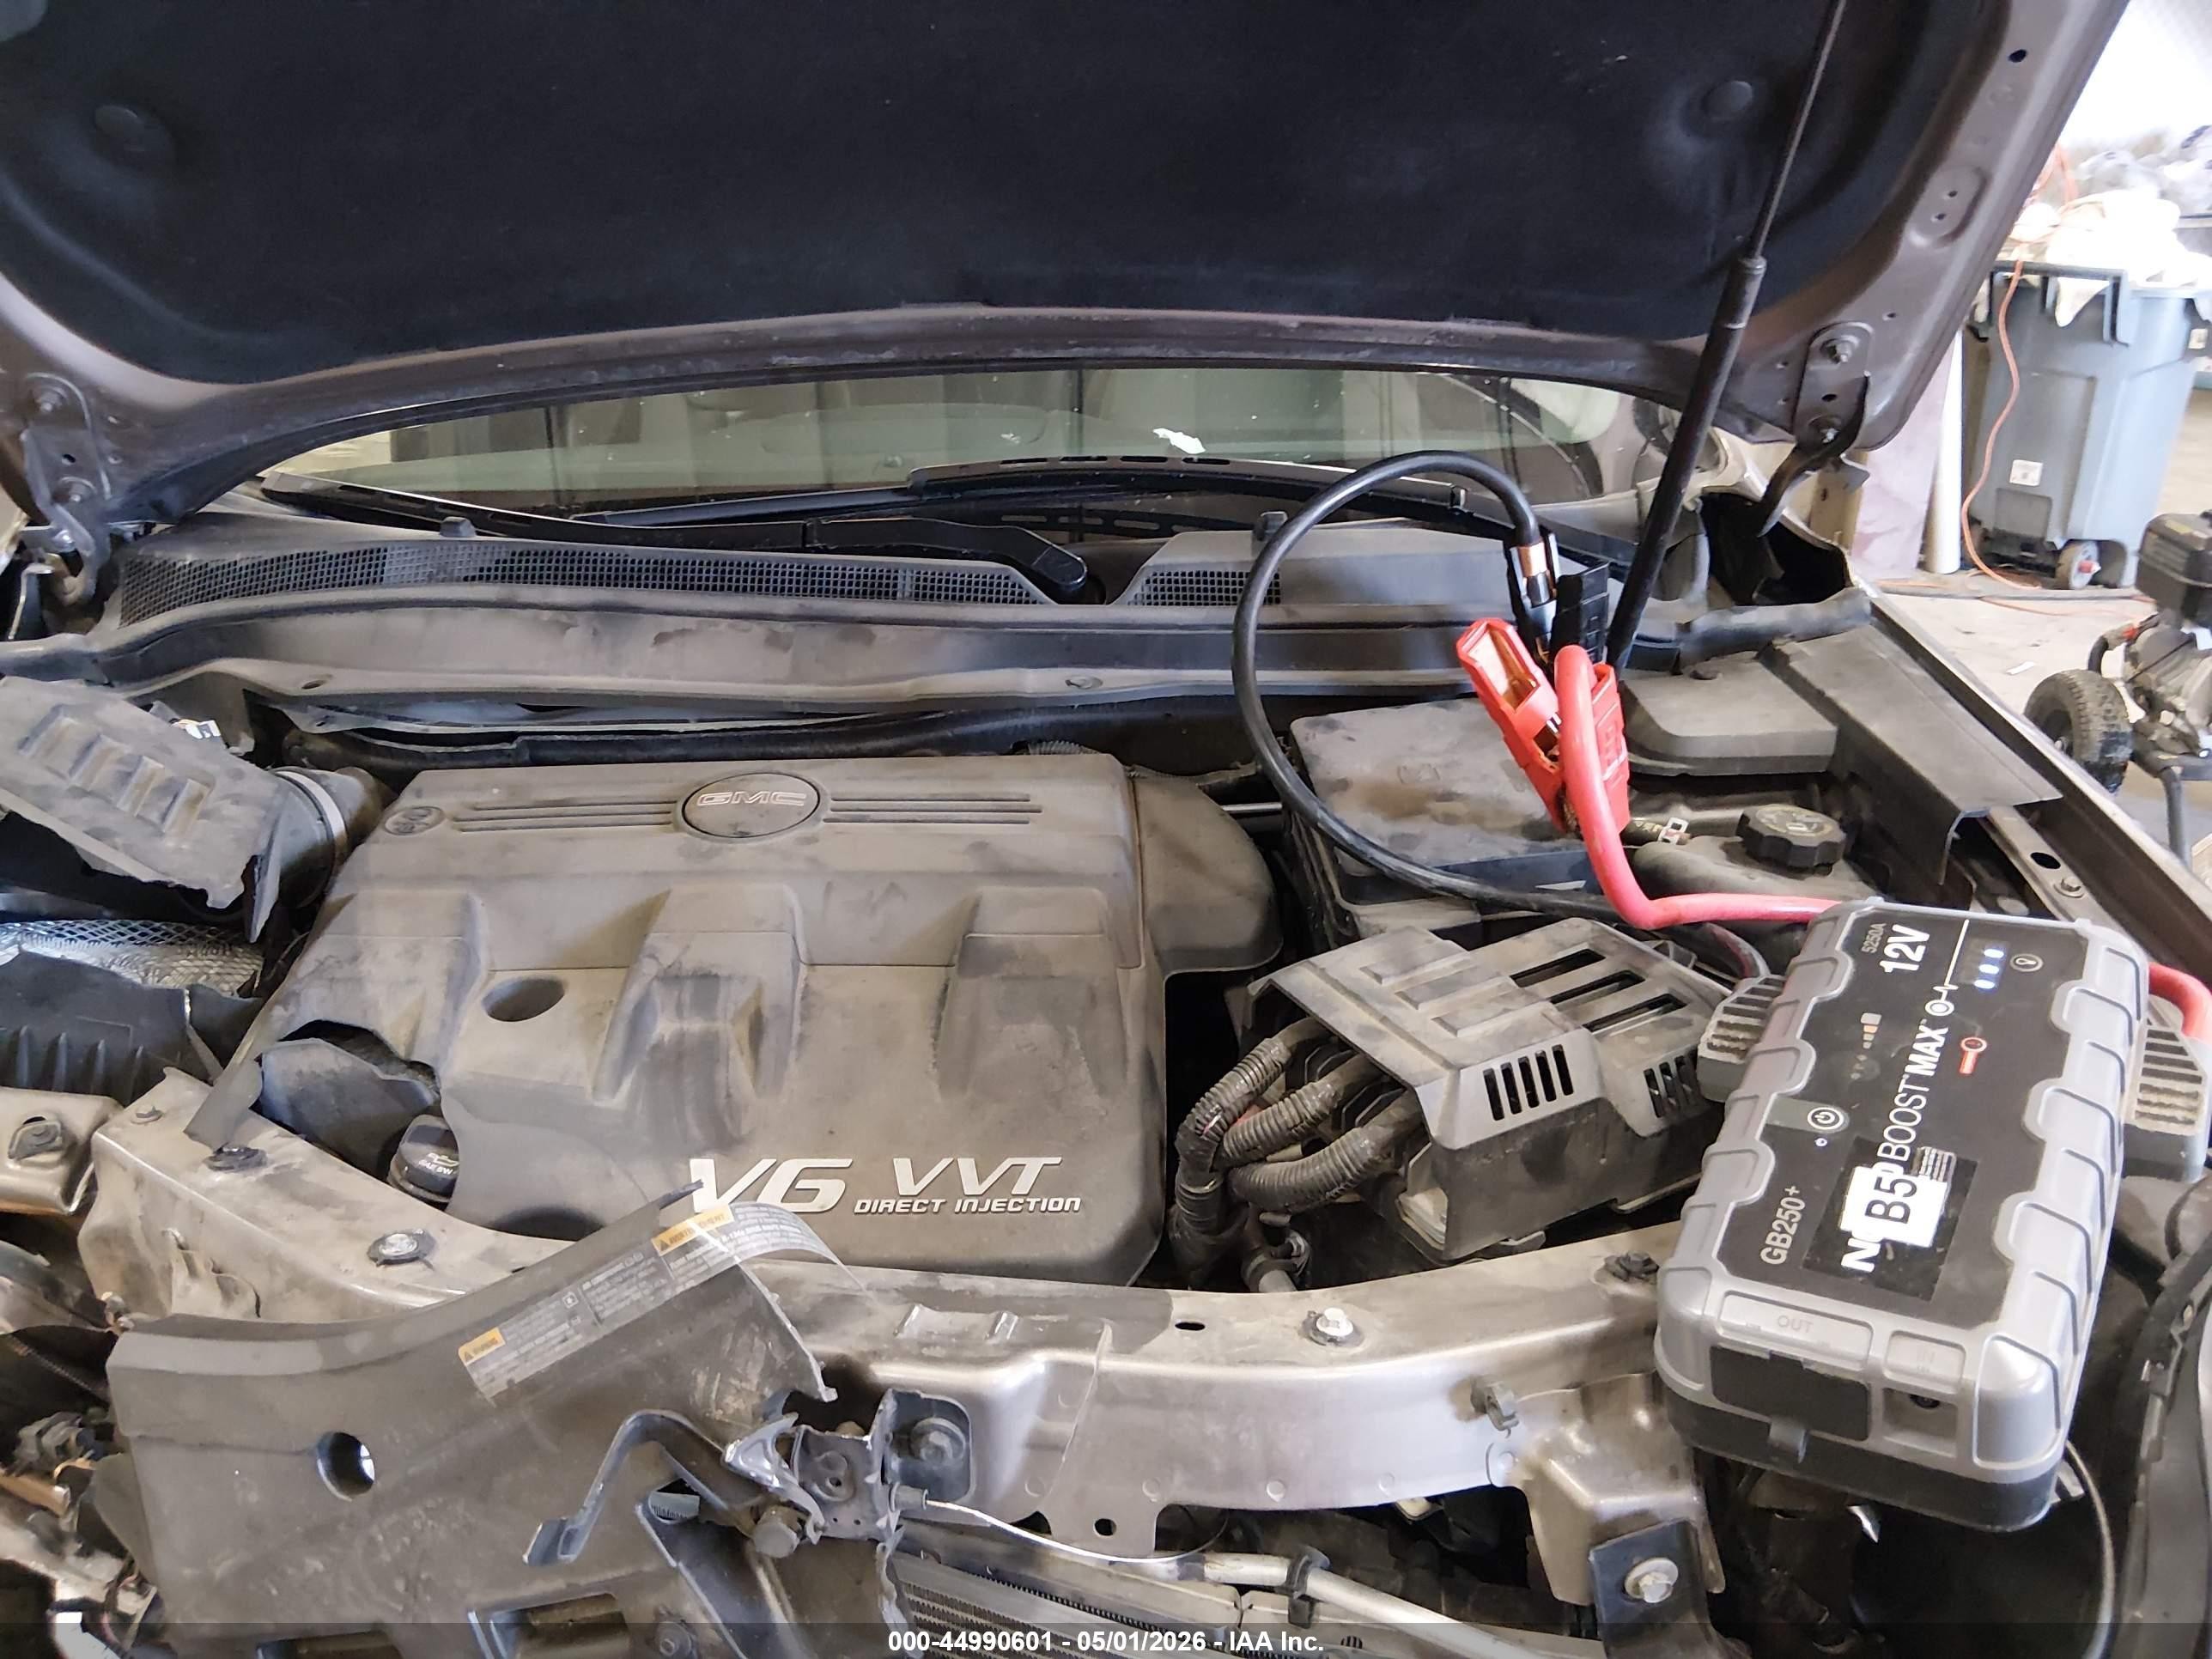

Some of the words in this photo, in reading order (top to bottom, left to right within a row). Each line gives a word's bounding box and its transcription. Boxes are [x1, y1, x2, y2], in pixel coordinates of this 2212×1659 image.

[696, 791, 807, 806] GMC
[1861, 922, 1887, 953] 5250A
[1879, 923, 1930, 973] 12V
[689, 1158, 854, 1213] V6
[892, 1157, 1063, 1195] VVT
[854, 1198, 947, 1213] DIRECT
[953, 1197, 1082, 1212] INJECTION
[1864, 1176, 1917, 1225] B5
[1759, 1184, 1807, 1266] GB250+
[1777, 1314, 1814, 1333] OUT
